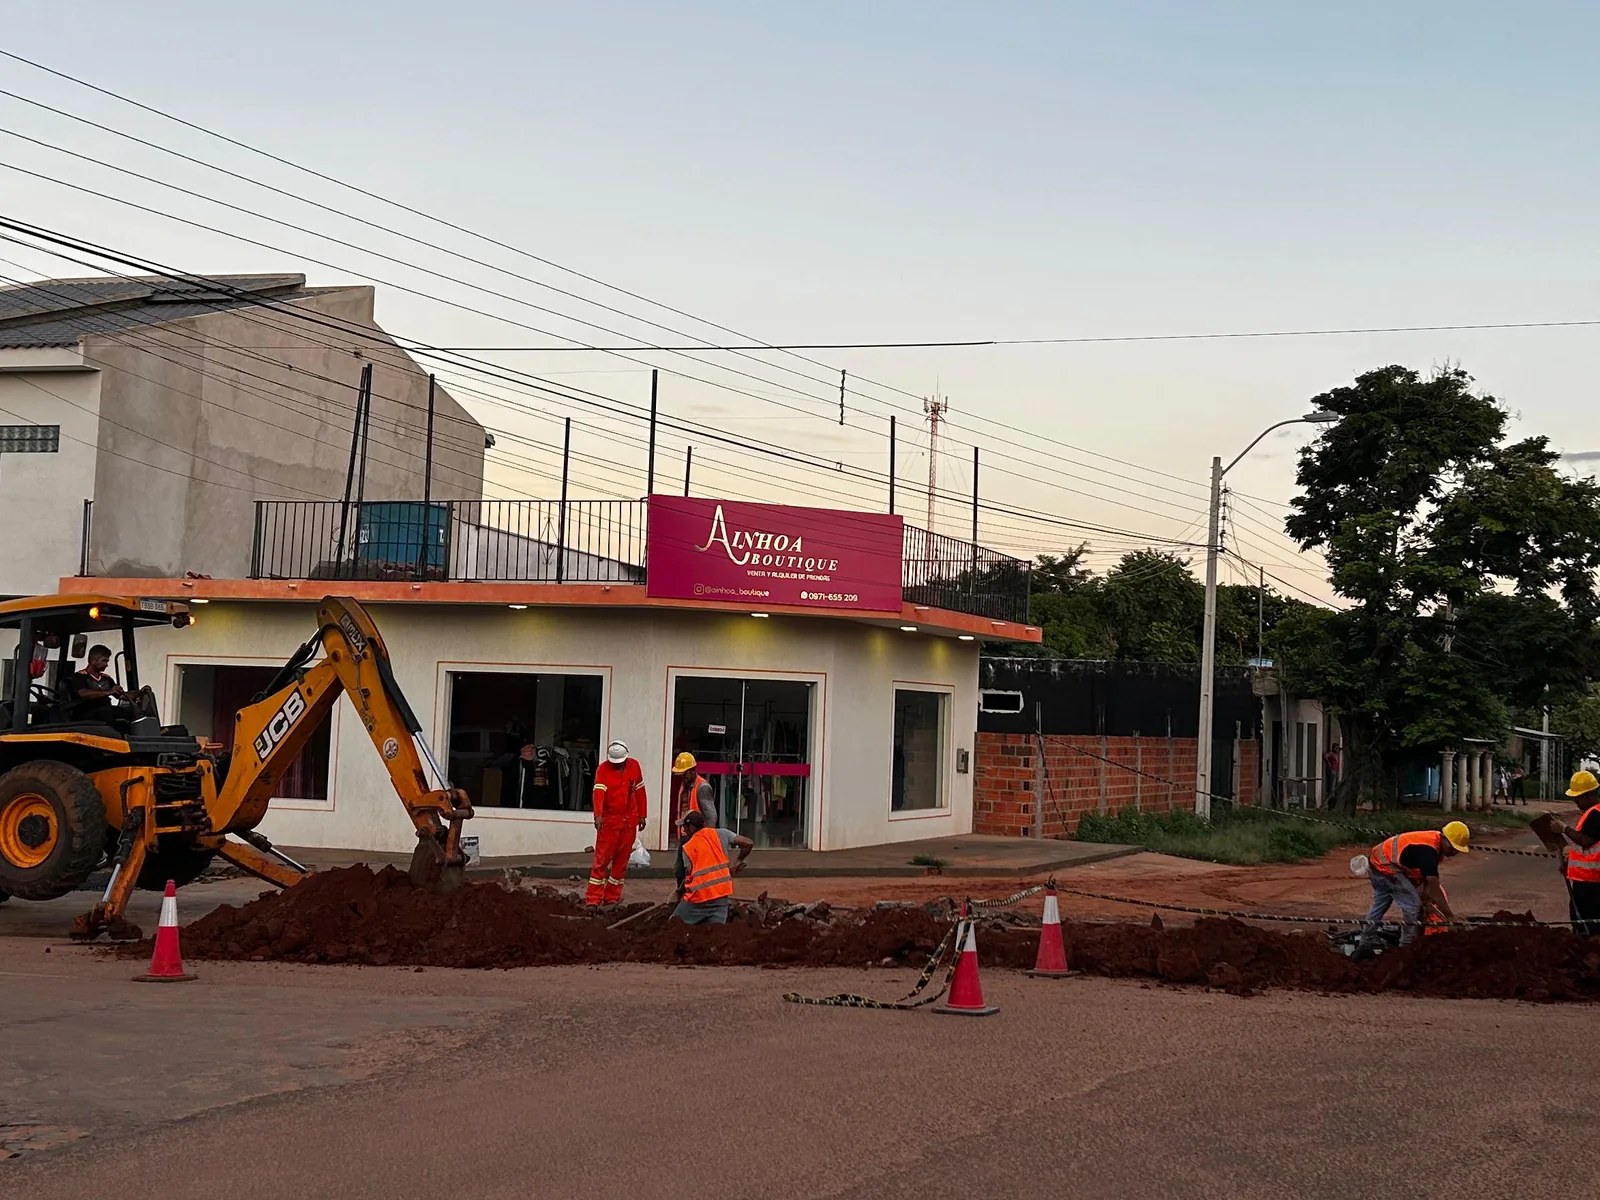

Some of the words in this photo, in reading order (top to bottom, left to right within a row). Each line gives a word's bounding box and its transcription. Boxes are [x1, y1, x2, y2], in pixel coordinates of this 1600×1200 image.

[694, 504, 802, 566] AINHOA
[750, 553, 839, 572] BOUTIQUE
[746, 569, 766, 577] VENTA
[772, 571, 798, 579] ALQUILER
[806, 574, 831, 582] PRENDAS
[843, 594, 858, 602] 209
[259, 691, 305, 759] JCB
